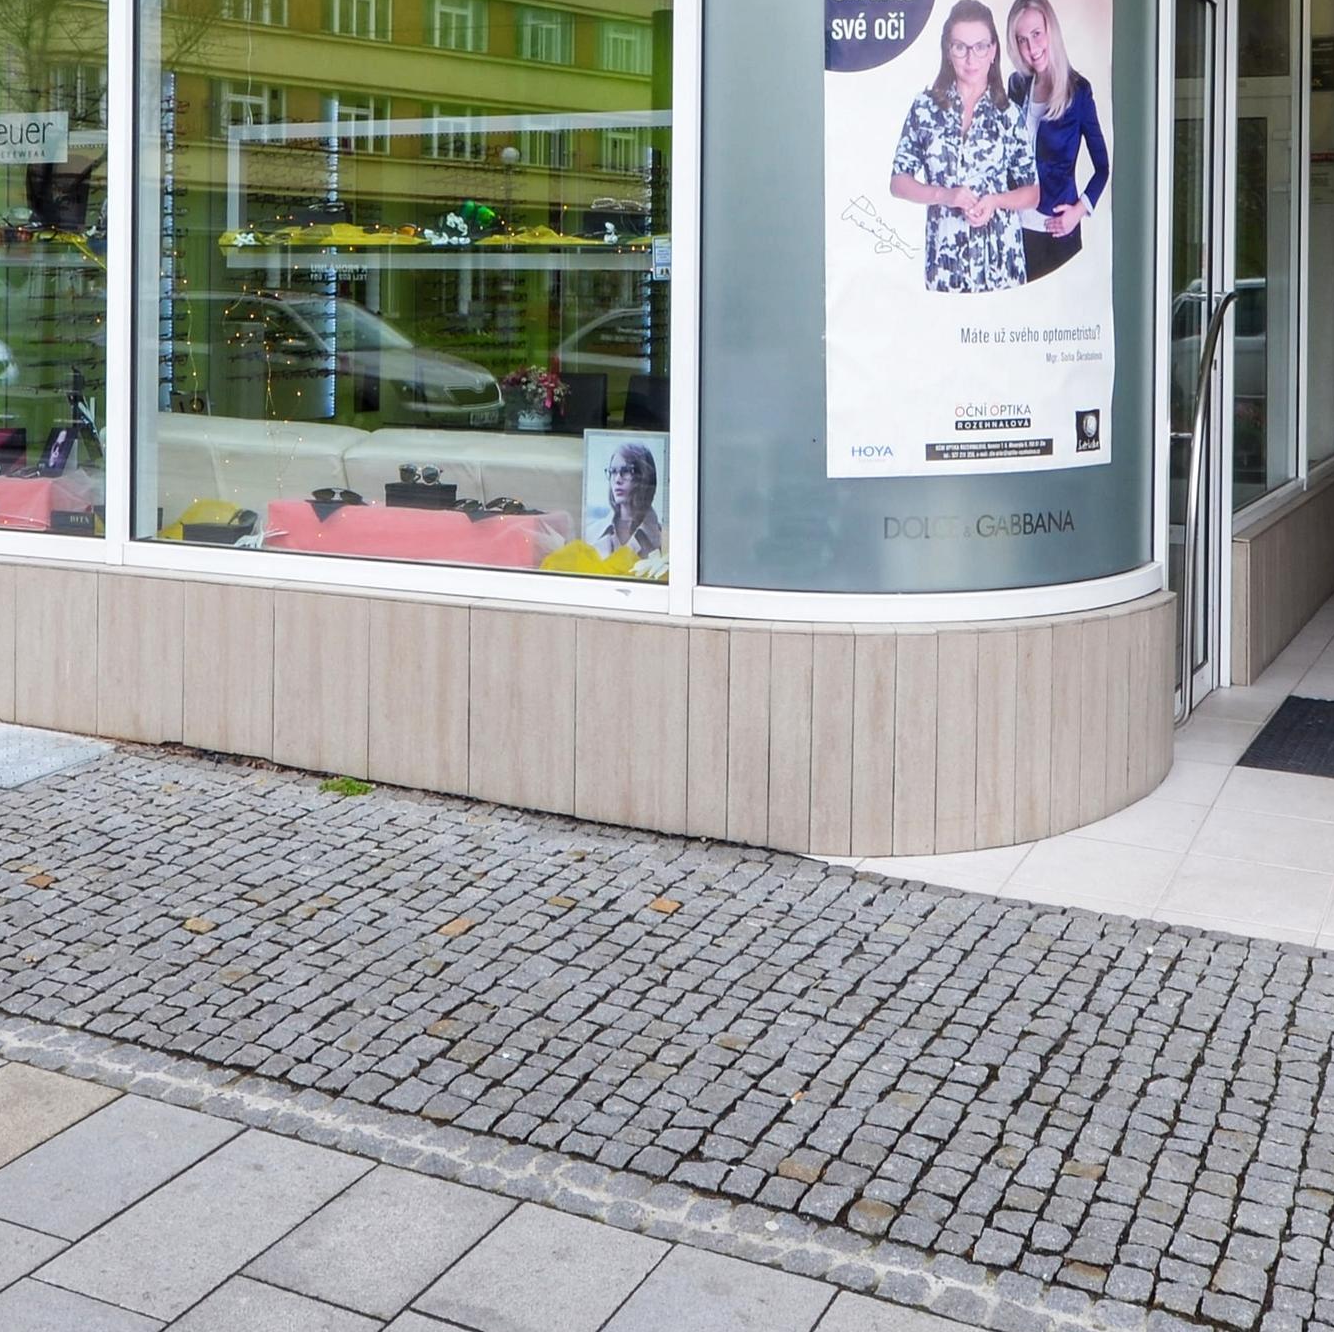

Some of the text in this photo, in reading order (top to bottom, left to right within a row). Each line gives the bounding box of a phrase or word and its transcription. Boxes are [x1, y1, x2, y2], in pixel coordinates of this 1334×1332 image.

[831, 12, 905, 40] své oči
[960, 324, 1102, 345] Máte už svého optometristu?
[955, 403, 1032, 417] OČNÍ OPTIKA
[957, 419, 1030, 430] ROZEHNALOVÁ
[851, 445, 894, 457] HOYA
[976, 510, 1075, 538] GABBANA
